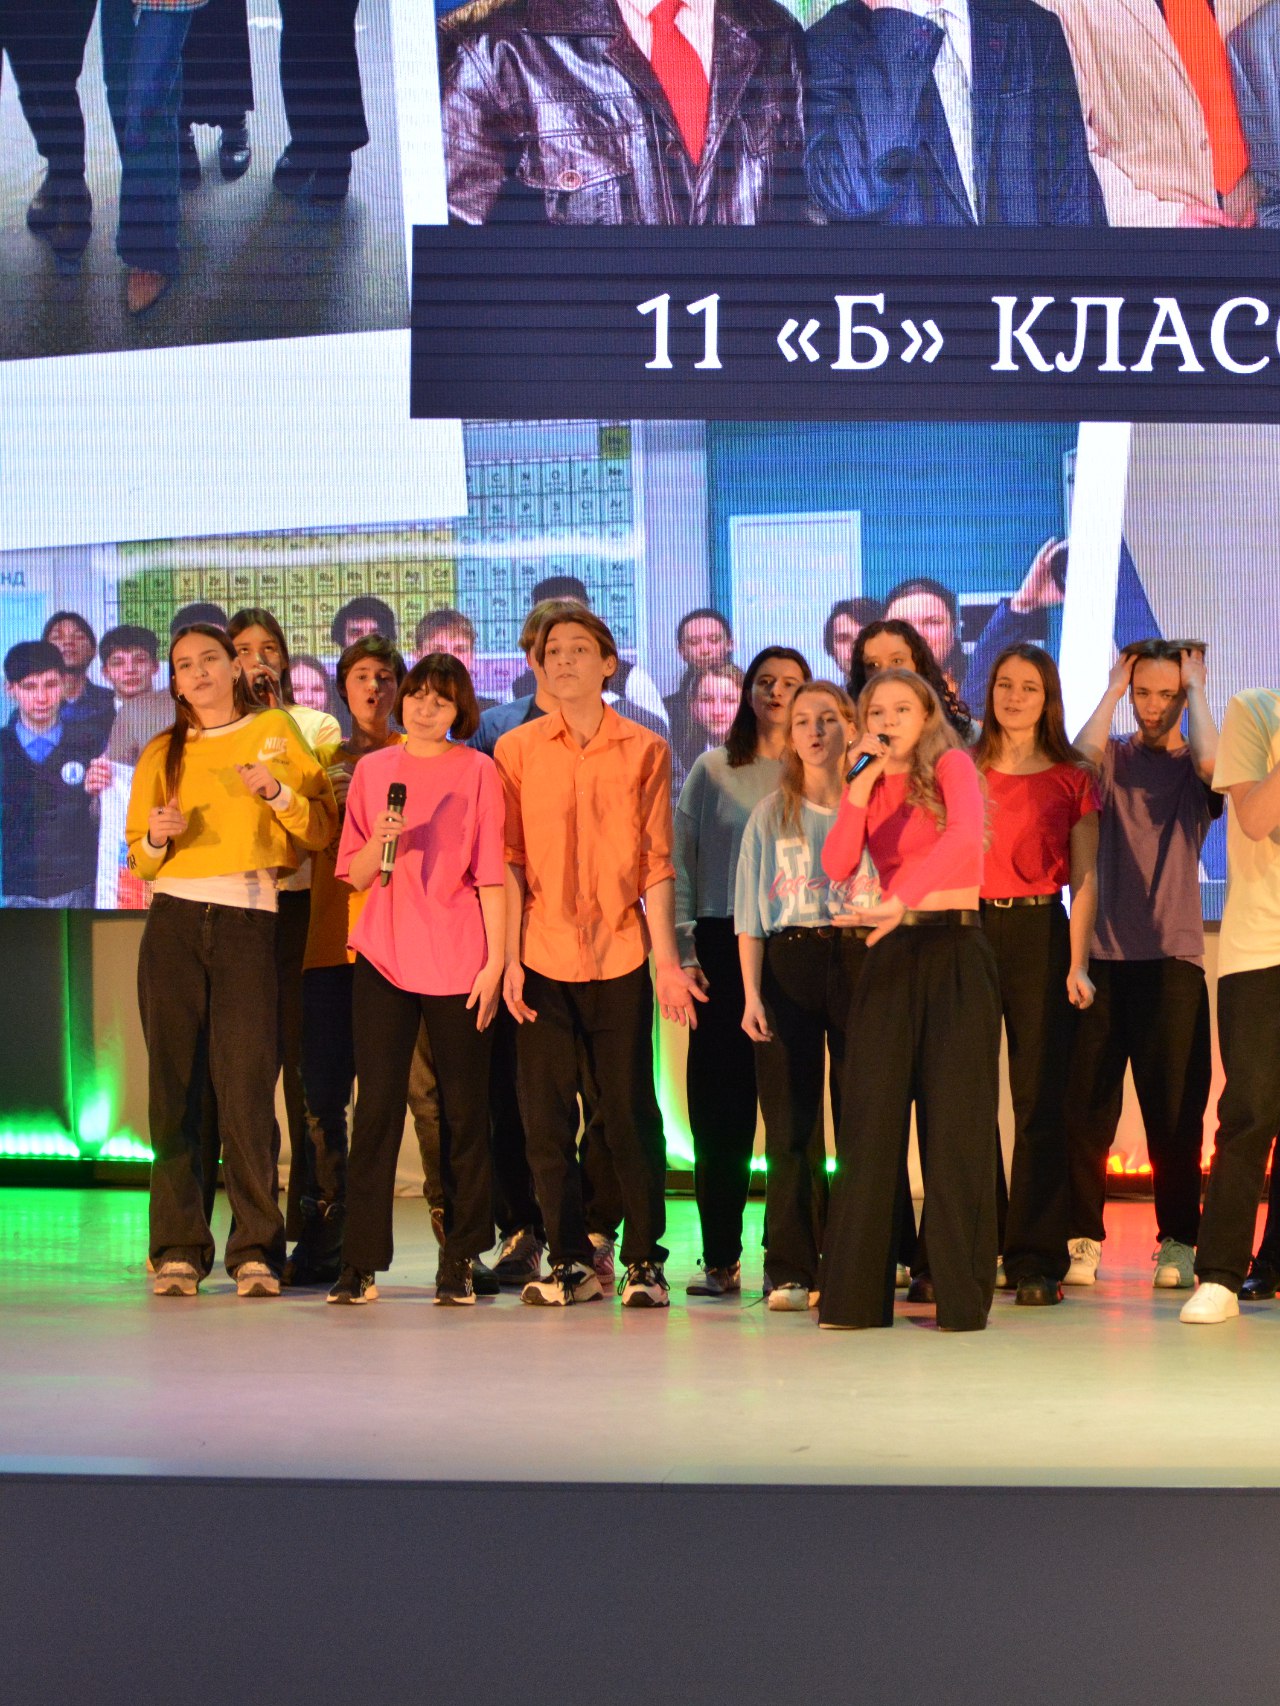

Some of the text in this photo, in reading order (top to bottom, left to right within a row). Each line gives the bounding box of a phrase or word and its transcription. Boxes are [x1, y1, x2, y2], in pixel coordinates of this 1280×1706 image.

[637, 293, 722, 368] 11
[777, 293, 943, 369] «Б»
[264, 736, 288, 752] NIKE
